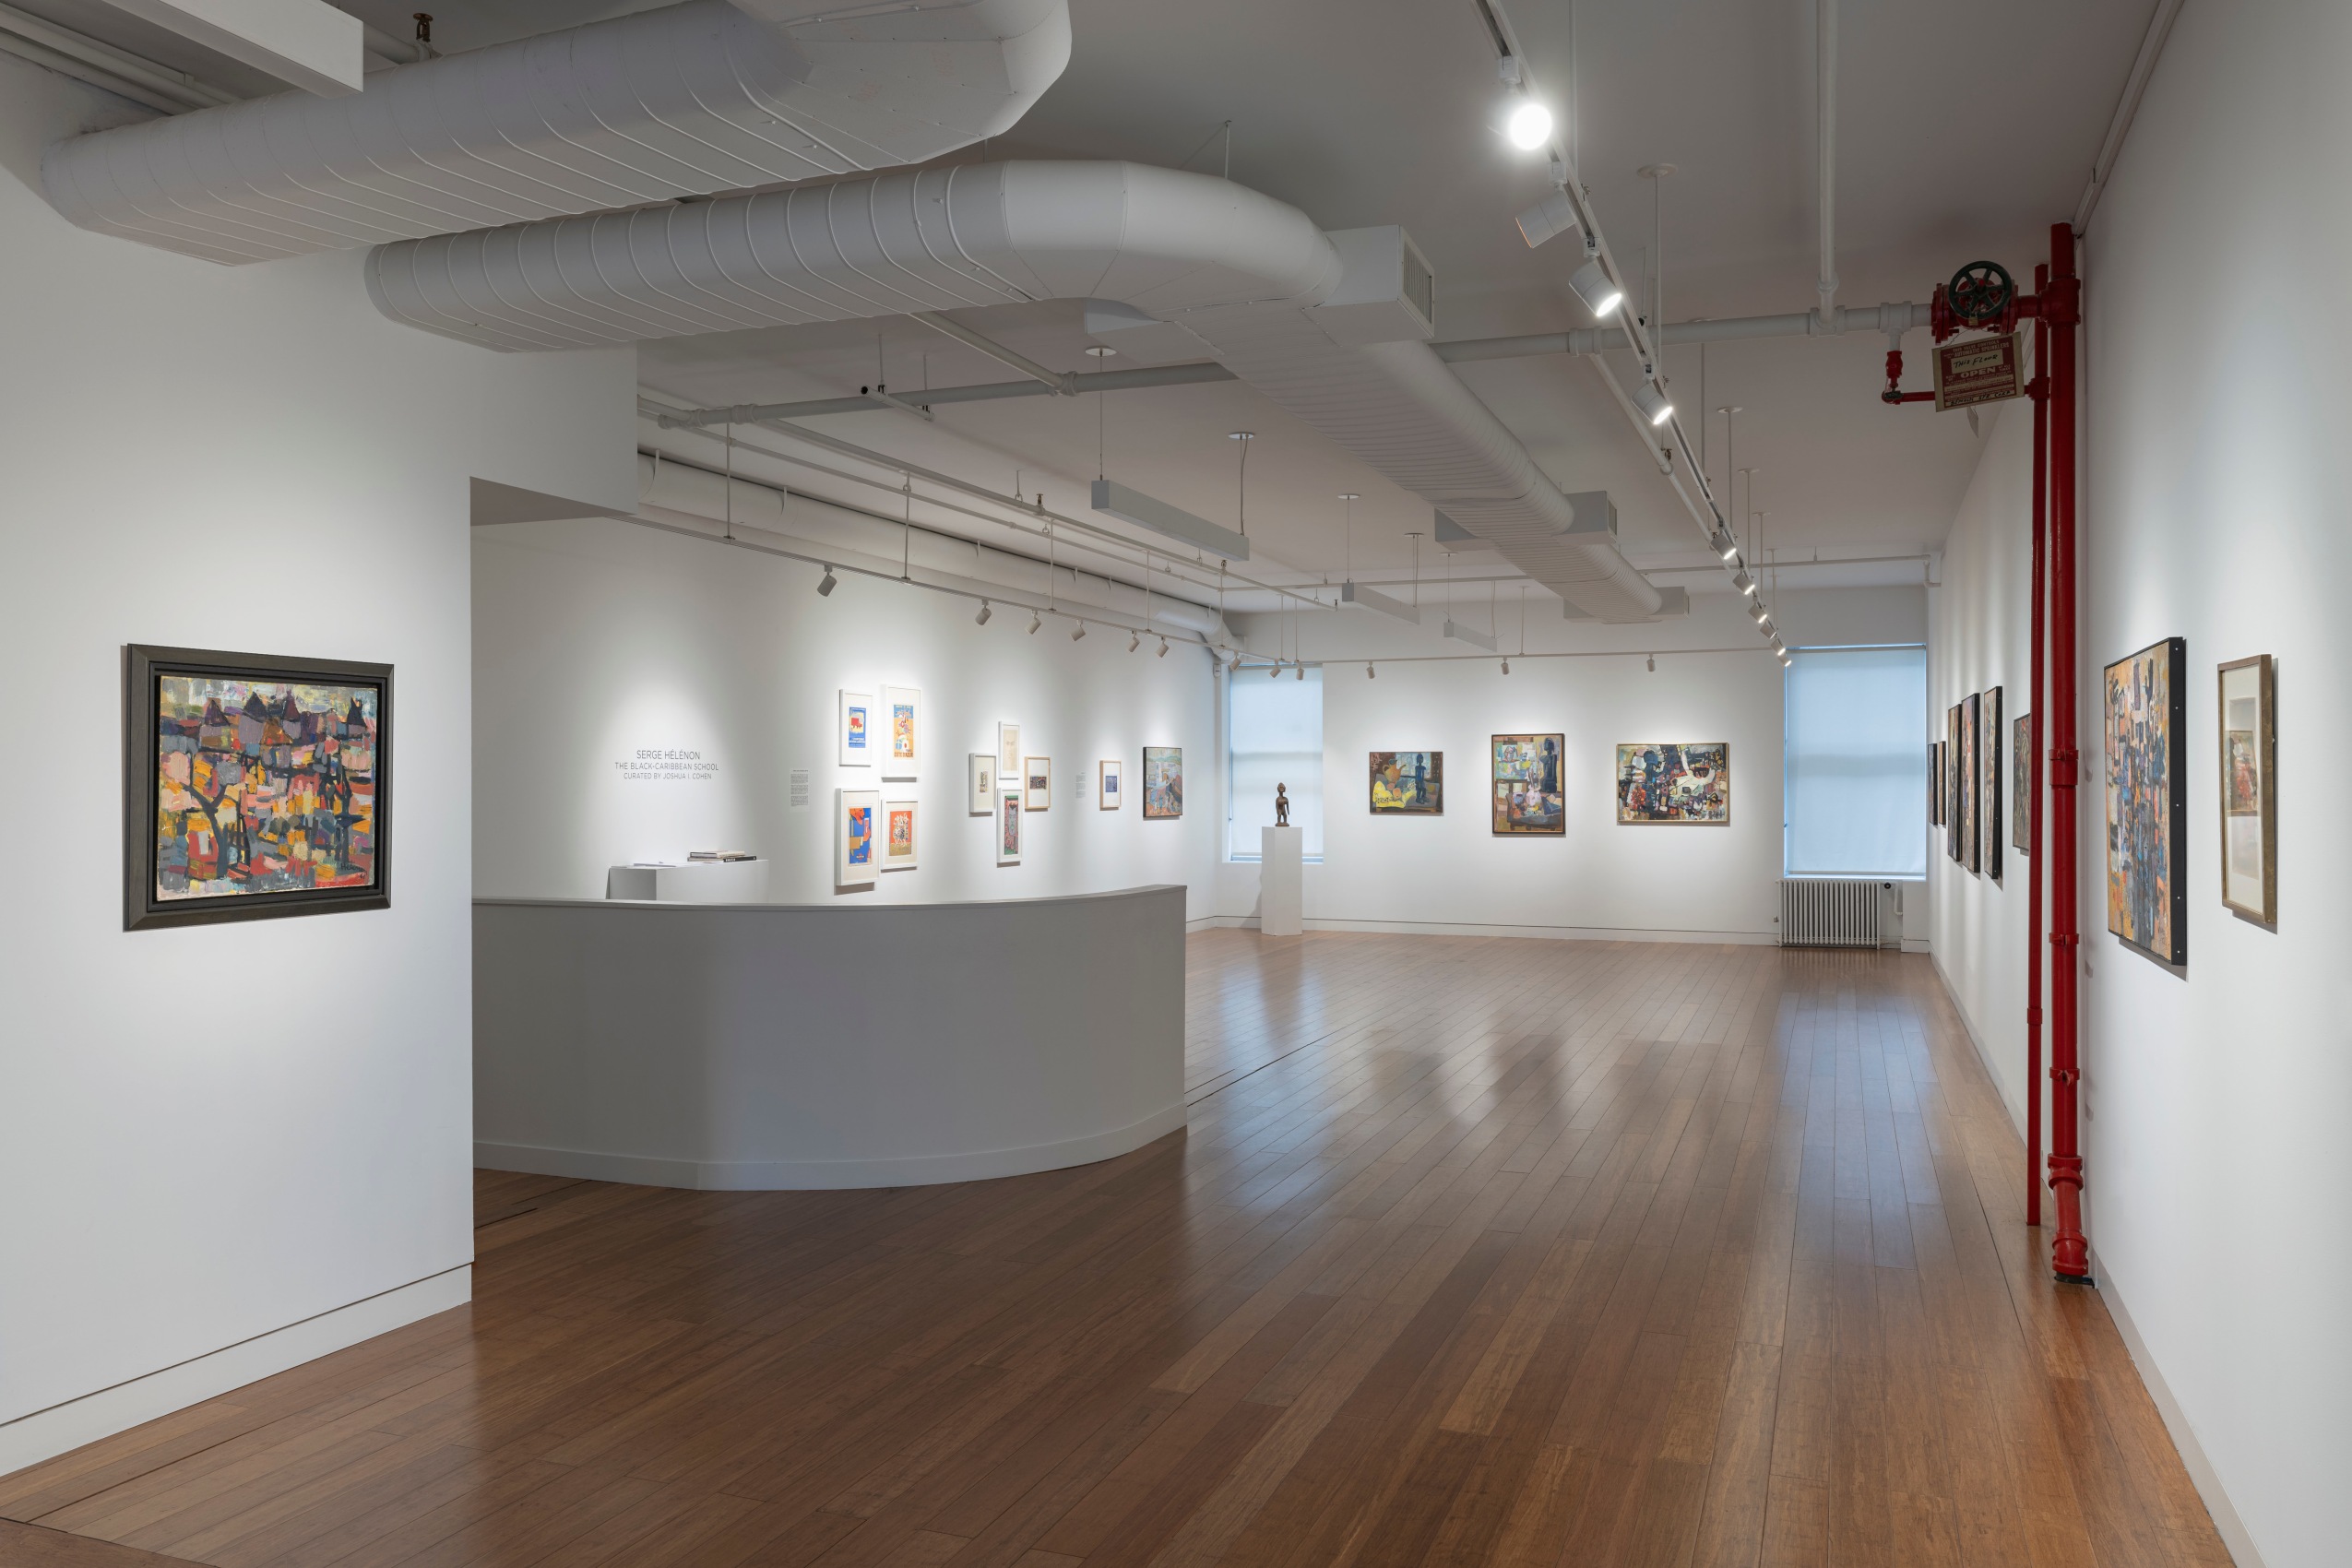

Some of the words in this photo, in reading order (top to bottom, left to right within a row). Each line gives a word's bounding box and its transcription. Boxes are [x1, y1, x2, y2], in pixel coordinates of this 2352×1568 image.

[1981, 342, 2010, 352] SPRINKLERS
[1961, 367, 1995, 378] OPEN
[636, 750, 662, 760] SERGE
[664, 748, 701, 760] HÉLÉNON
[630, 762, 693, 770] BLACK-CARIBBEAN
[694, 763, 719, 771] SCHOOL
